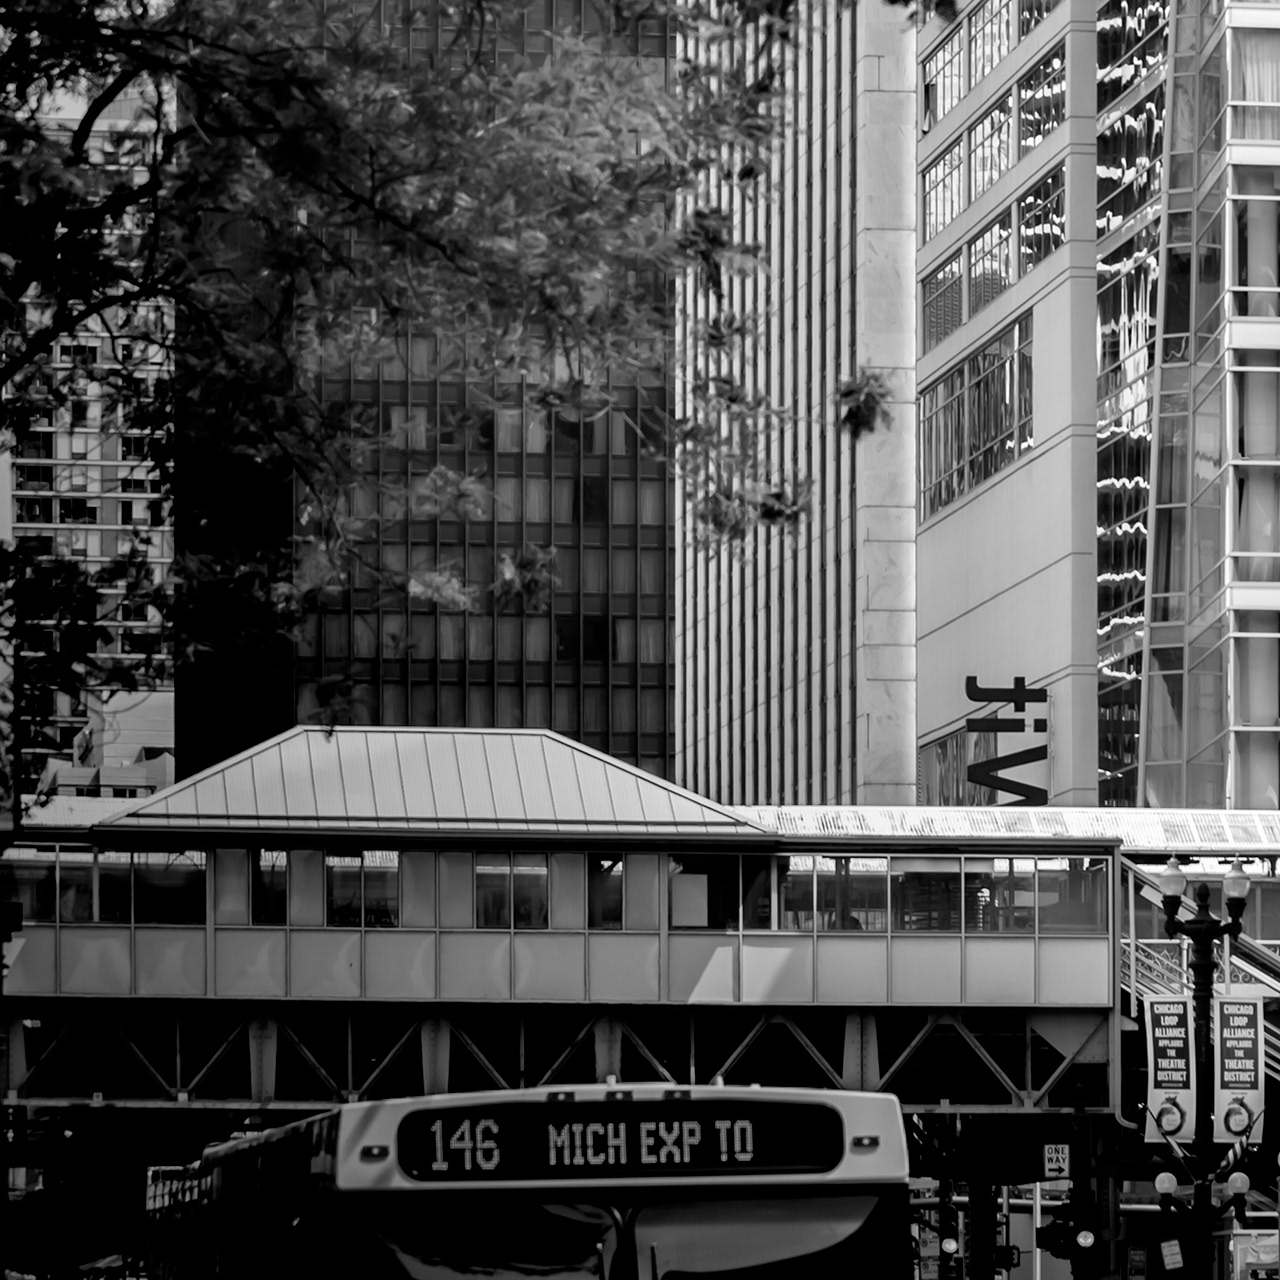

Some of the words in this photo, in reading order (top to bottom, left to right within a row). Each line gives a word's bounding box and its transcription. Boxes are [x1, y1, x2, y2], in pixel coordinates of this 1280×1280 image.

[1154, 1004, 1183, 1014] CHICAGO
[1224, 1005, 1253, 1014] CHICAGO
[1161, 1016, 1178, 1025] LOOP
[1230, 1017, 1248, 1026] LOOP
[1155, 1028, 1185, 1038] ALLIANCE
[1223, 1028, 1255, 1038] ALLIANCE
[1158, 1059, 1186, 1069] THEATRE
[1225, 1060, 1254, 1070] THEATRE
[1157, 1071, 1186, 1081] DISTRICT
[1224, 1071, 1255, 1081] DISTRICT
[431, 1119, 500, 1171] 146
[548, 1123, 627, 1166] MICH
[640, 1121, 701, 1164] EXP
[714, 1120, 753, 1162] TO
[1047, 1146, 1067, 1155] ONE
[1047, 1156, 1067, 1164] WAY
